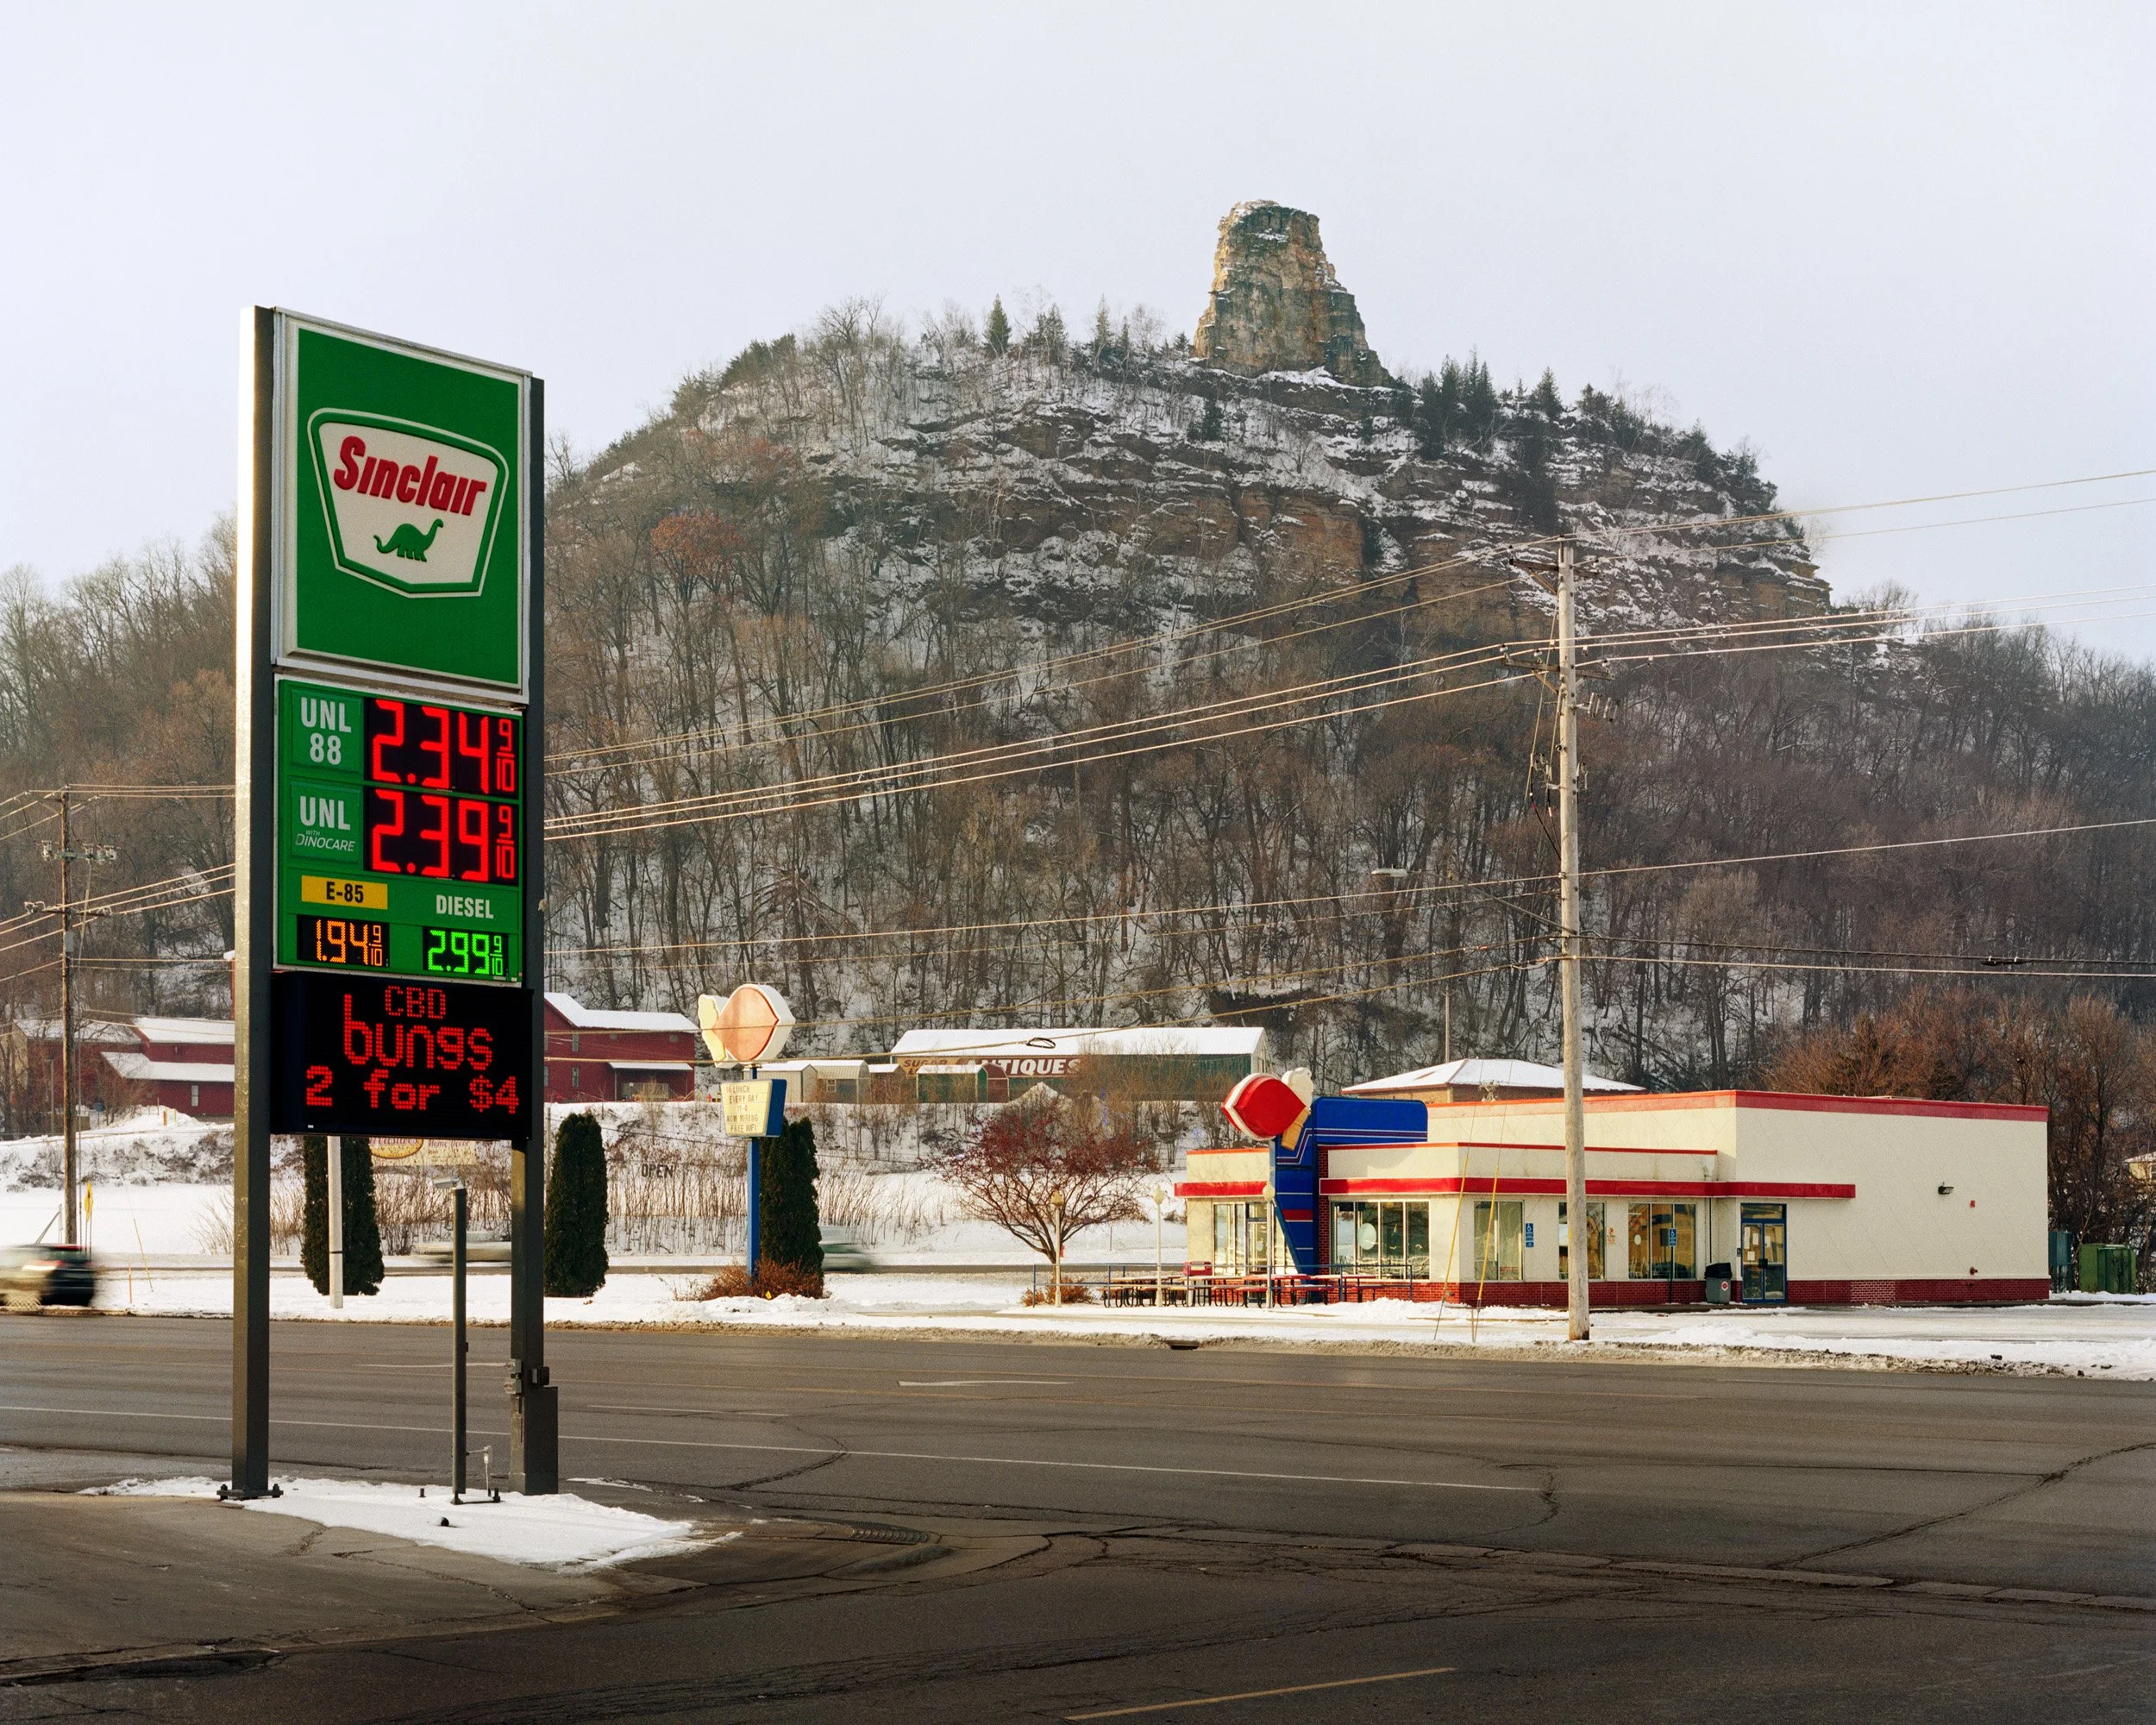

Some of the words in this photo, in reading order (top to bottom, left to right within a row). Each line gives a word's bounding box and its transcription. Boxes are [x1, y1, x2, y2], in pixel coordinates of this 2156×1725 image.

[333, 435, 487, 517] Sinclair
[300, 696, 352, 733] UNL
[373, 699, 489, 794] 2.34
[310, 733, 342, 765] 88
[295, 833, 355, 852] DINOCARE
[299, 795, 351, 831] UNL
[373, 788, 489, 882] 2.39
[326, 881, 364, 903] E-85
[436, 894, 494, 919] DIESEL
[316, 919, 368, 966] 1.94
[428, 930, 490, 975] 2.99
[385, 986, 446, 1019] CBD
[344, 994, 493, 1070] bungs
[306, 1065, 333, 1107] 2
[363, 1069, 441, 1110] for
[468, 1075, 519, 1114] $4
[730, 1095, 746, 1104] EVERY
[730, 1124, 744, 1132] FREE
[641, 1164, 674, 1179] OPEN
